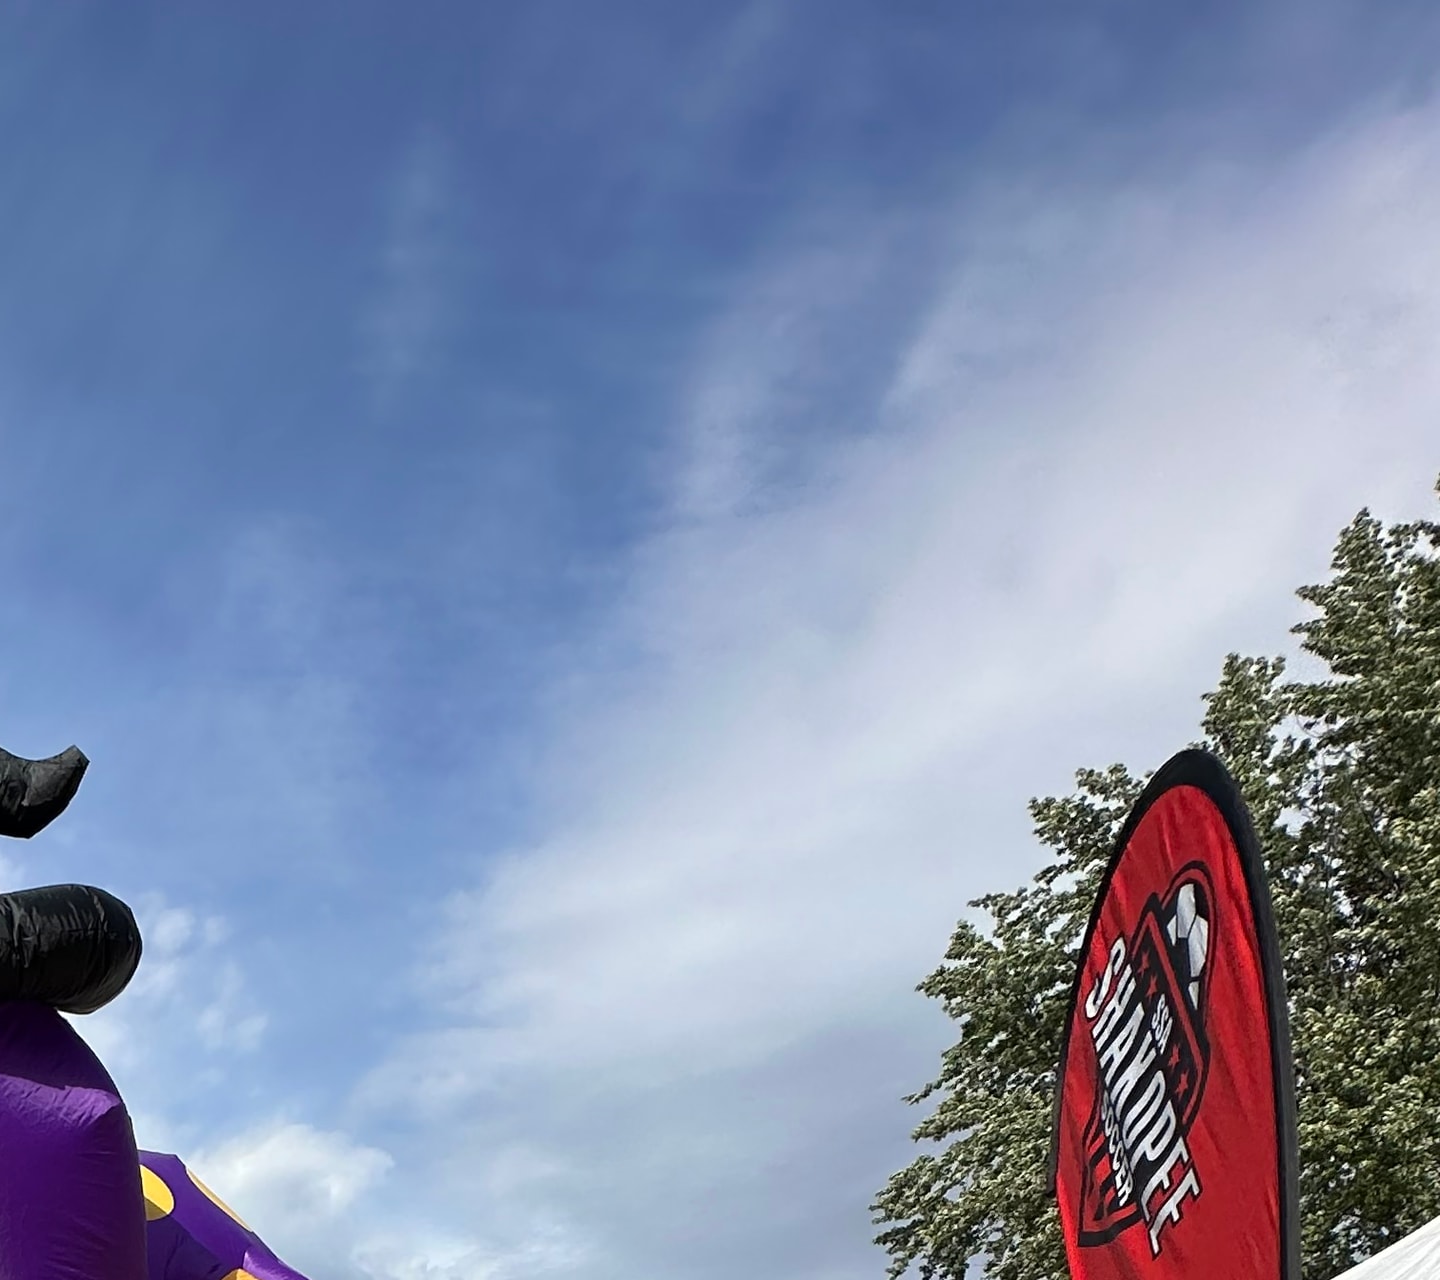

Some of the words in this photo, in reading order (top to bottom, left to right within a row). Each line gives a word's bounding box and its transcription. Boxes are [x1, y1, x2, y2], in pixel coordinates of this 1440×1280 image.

[1152, 993, 1174, 1054] SSA
[1085, 936, 1200, 1255] SHAKOPEE
[1101, 1092, 1133, 1206] SOCCER
